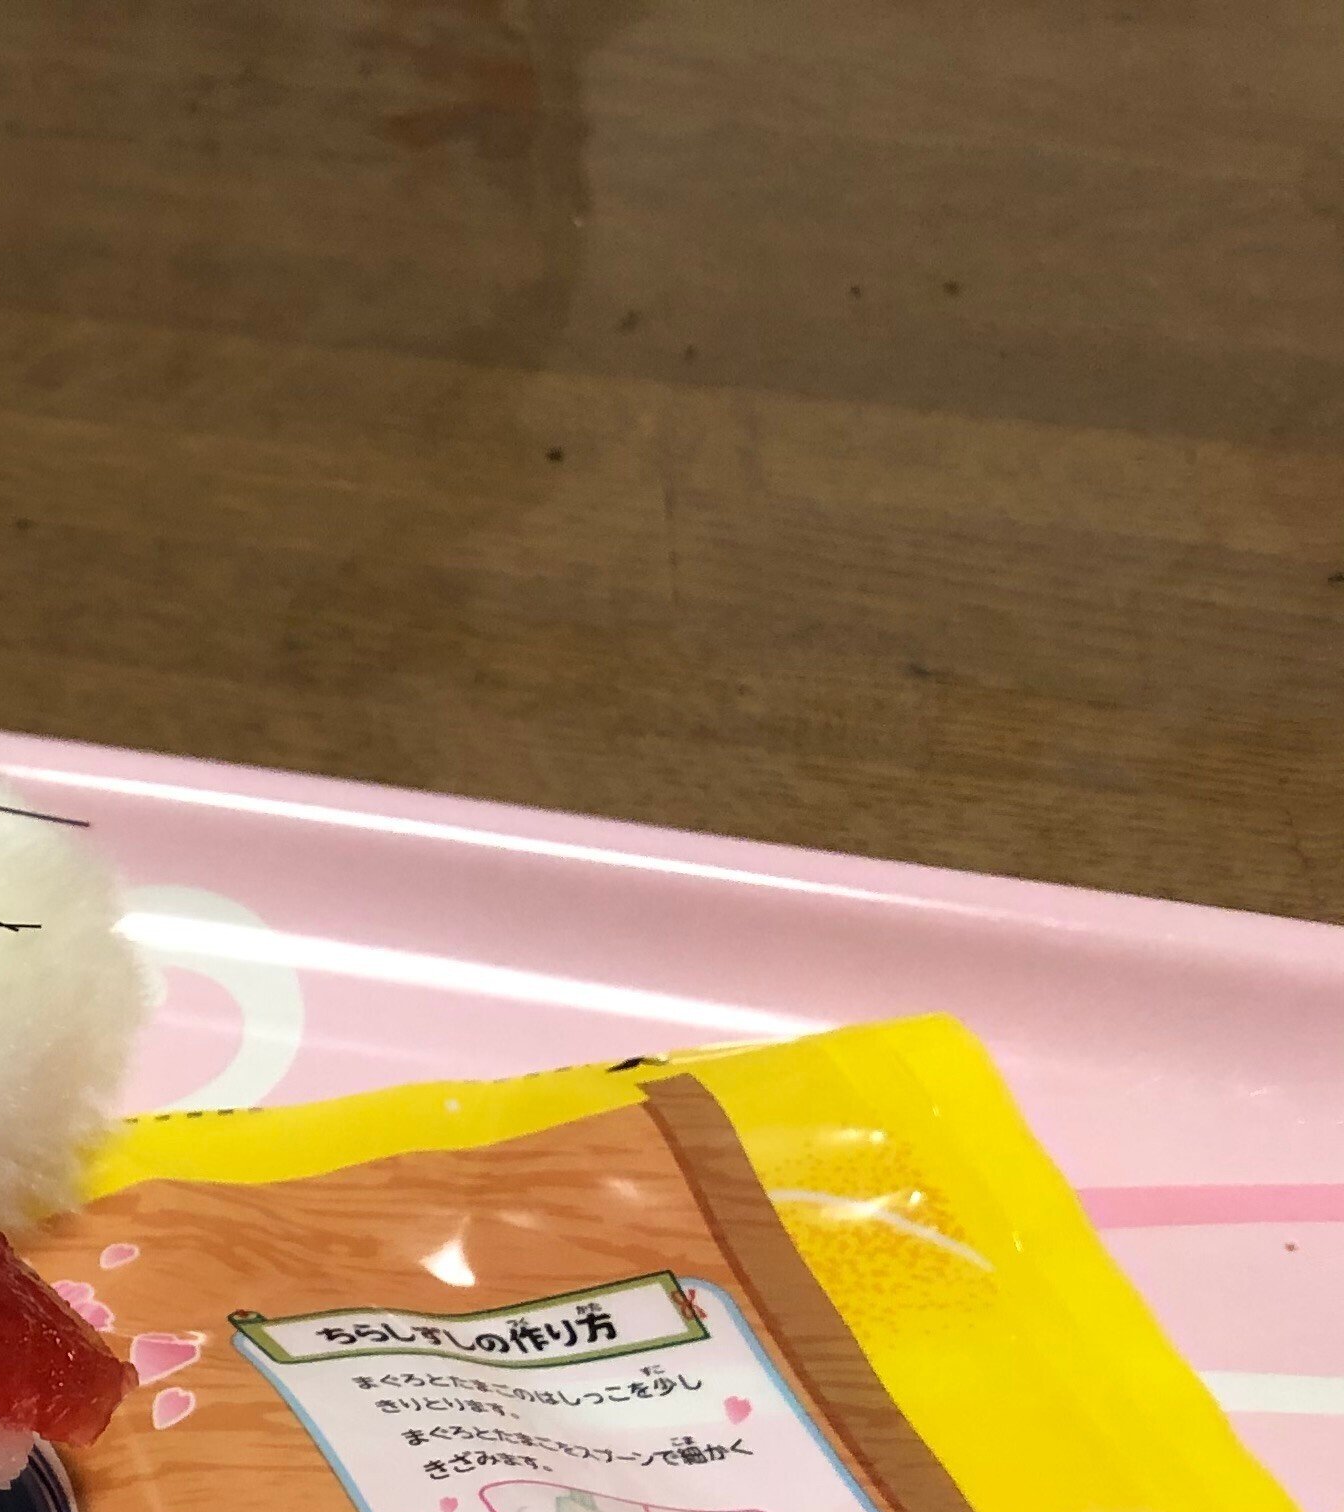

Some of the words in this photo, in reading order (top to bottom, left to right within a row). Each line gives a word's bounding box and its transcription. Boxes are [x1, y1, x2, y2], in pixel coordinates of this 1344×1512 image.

[316, 1312, 617, 1354] ちらしずしの作り方
[423, 1450, 554, 1480] きざみます。
